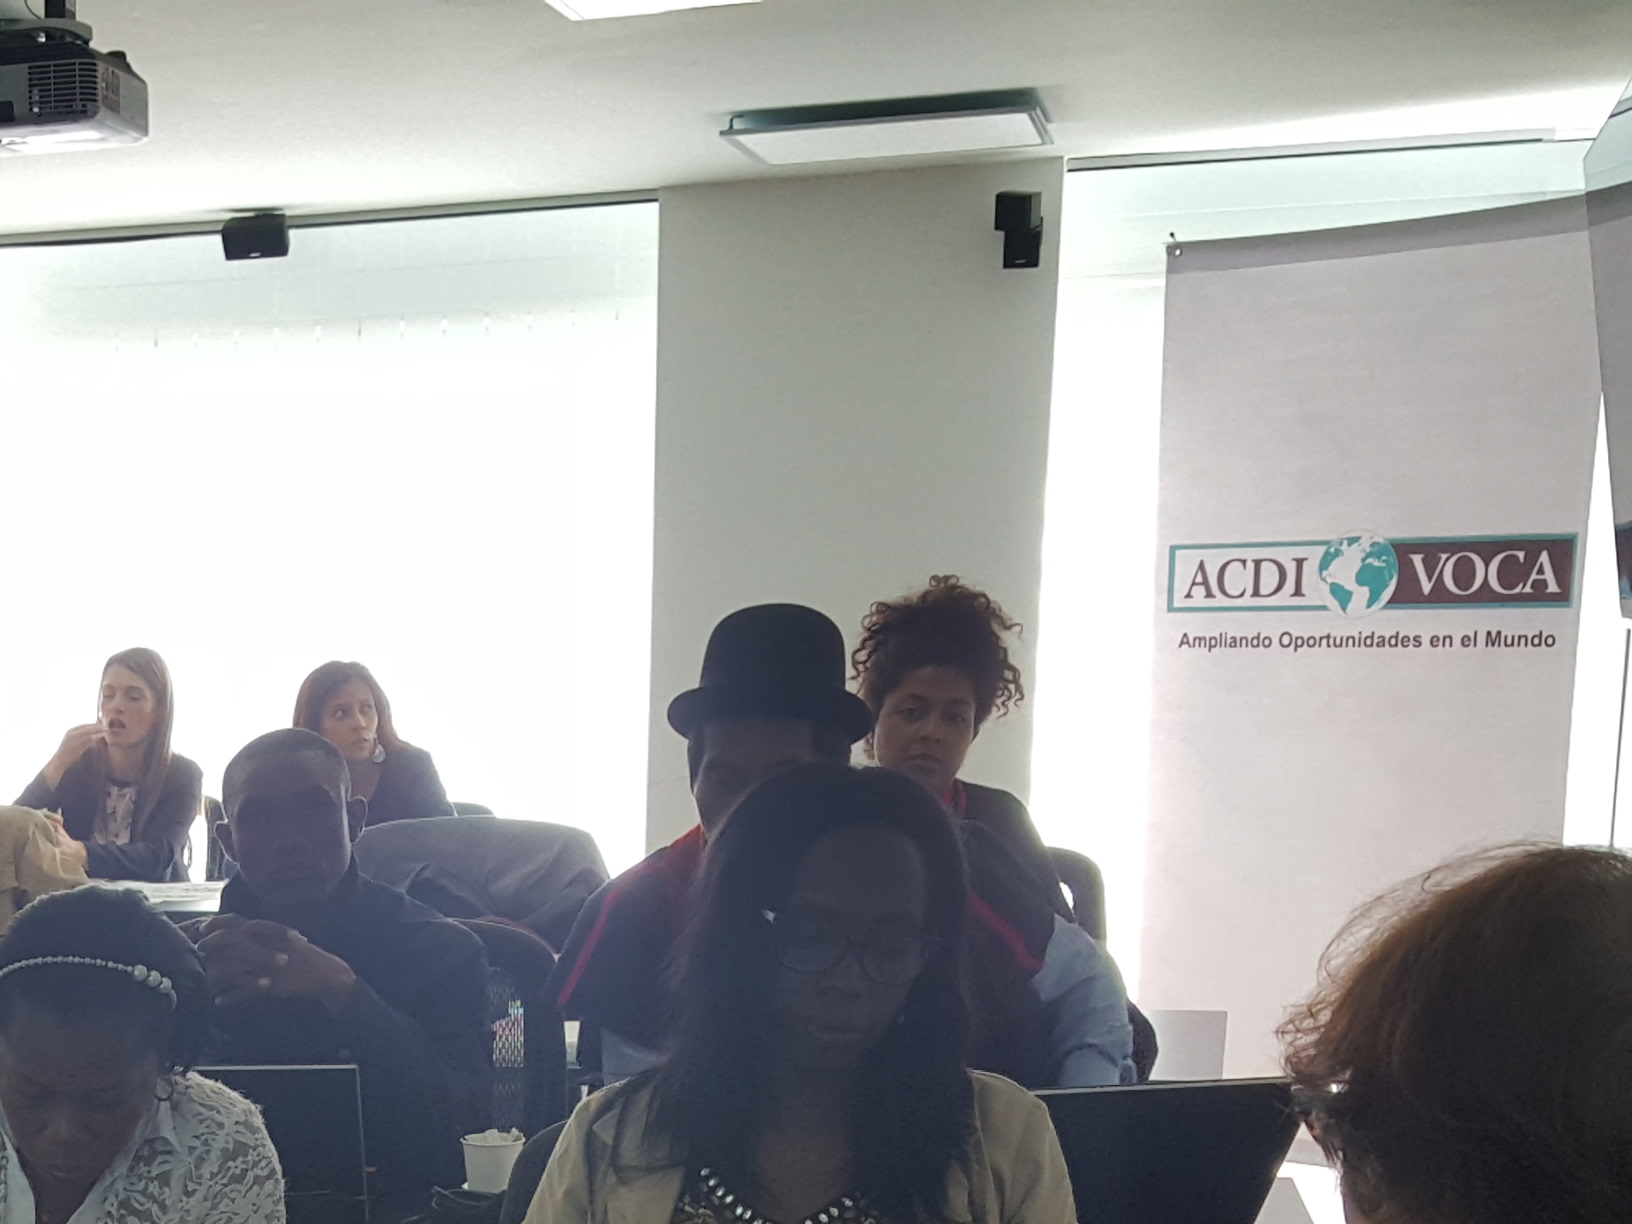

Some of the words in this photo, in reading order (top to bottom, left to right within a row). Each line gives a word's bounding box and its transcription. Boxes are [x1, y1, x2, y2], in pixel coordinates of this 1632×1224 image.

[1183, 557, 1309, 599] ACDI
[1408, 549, 1563, 597] VOCA
[1178, 631, 1273, 653] Ampliando
[1278, 630, 1423, 653] Oportunidades
[1429, 634, 1454, 648] en
[1460, 630, 1478, 648] el
[1485, 629, 1557, 648] Mundo
